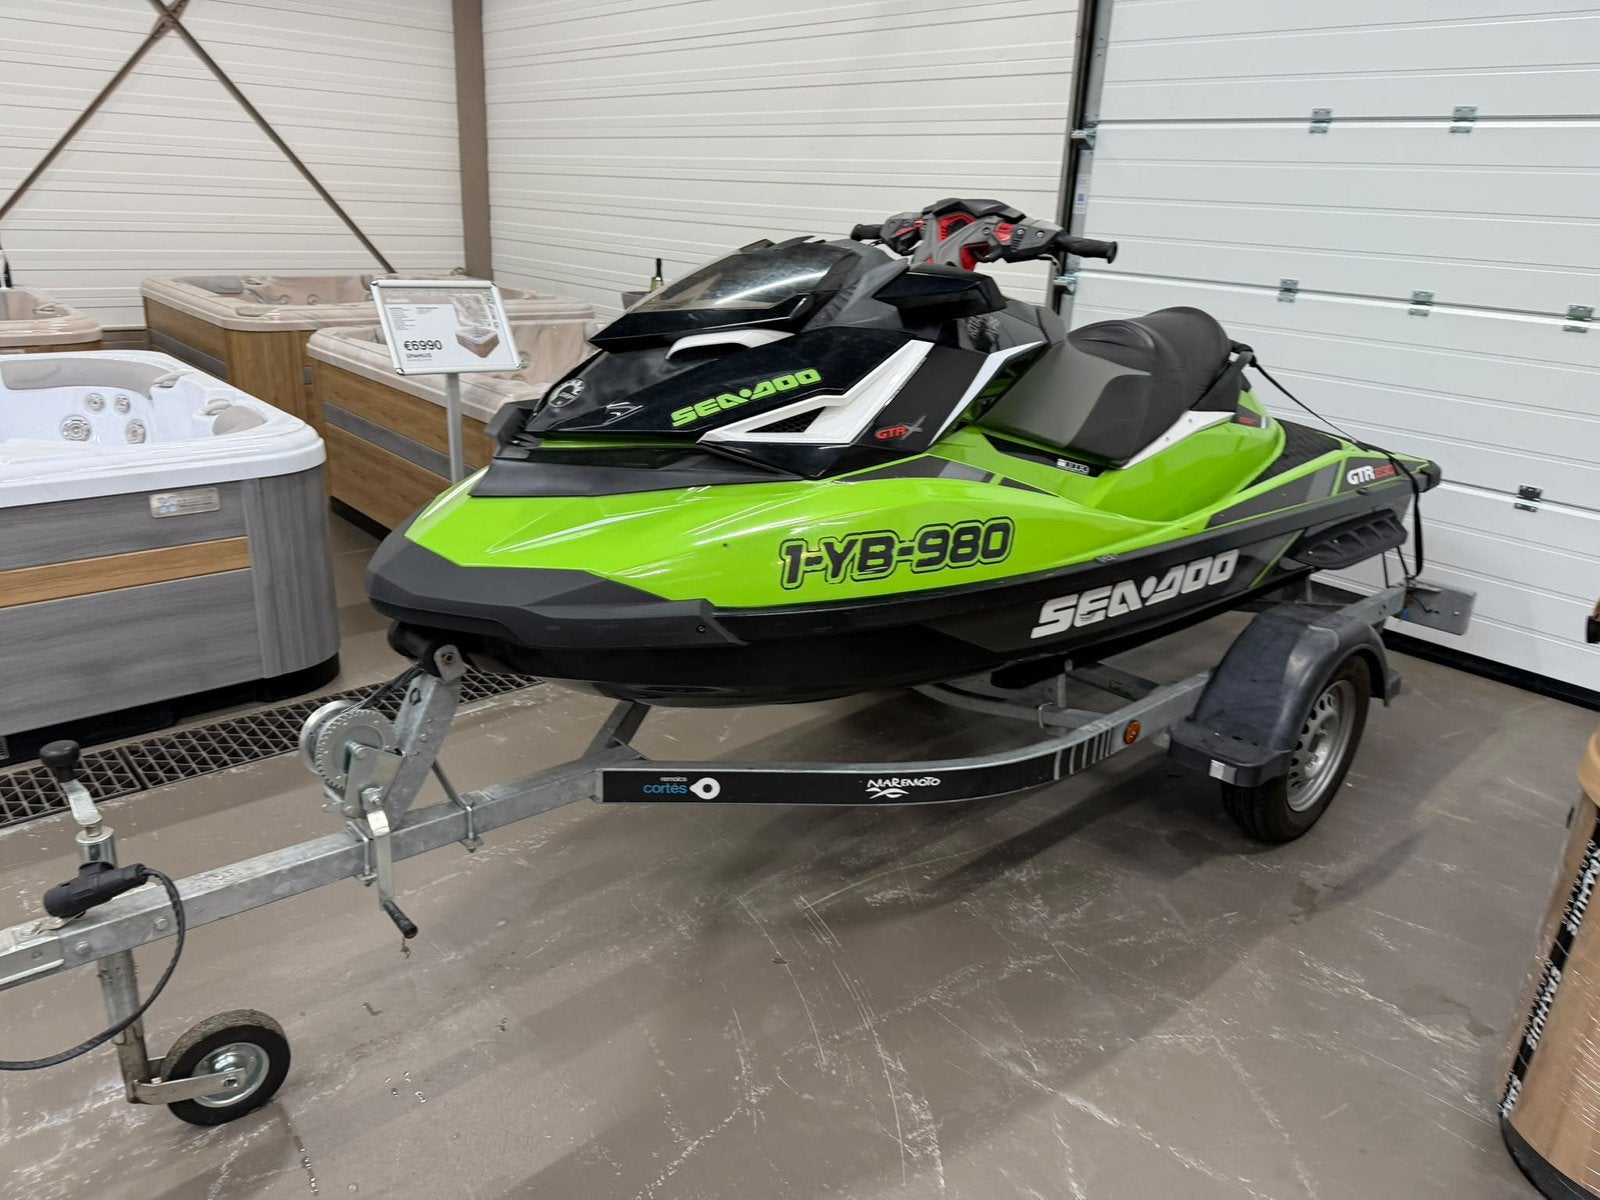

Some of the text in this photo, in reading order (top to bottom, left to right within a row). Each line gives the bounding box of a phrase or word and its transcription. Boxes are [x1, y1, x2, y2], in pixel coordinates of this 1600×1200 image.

[404, 339, 443, 351] €6990
[1346, 465, 1376, 485] GTR
[781, 517, 1015, 590] 1-YB-980
[867, 776, 941, 788] MAREMOTO
[1526, 966, 1562, 1051] SPAHUIS
